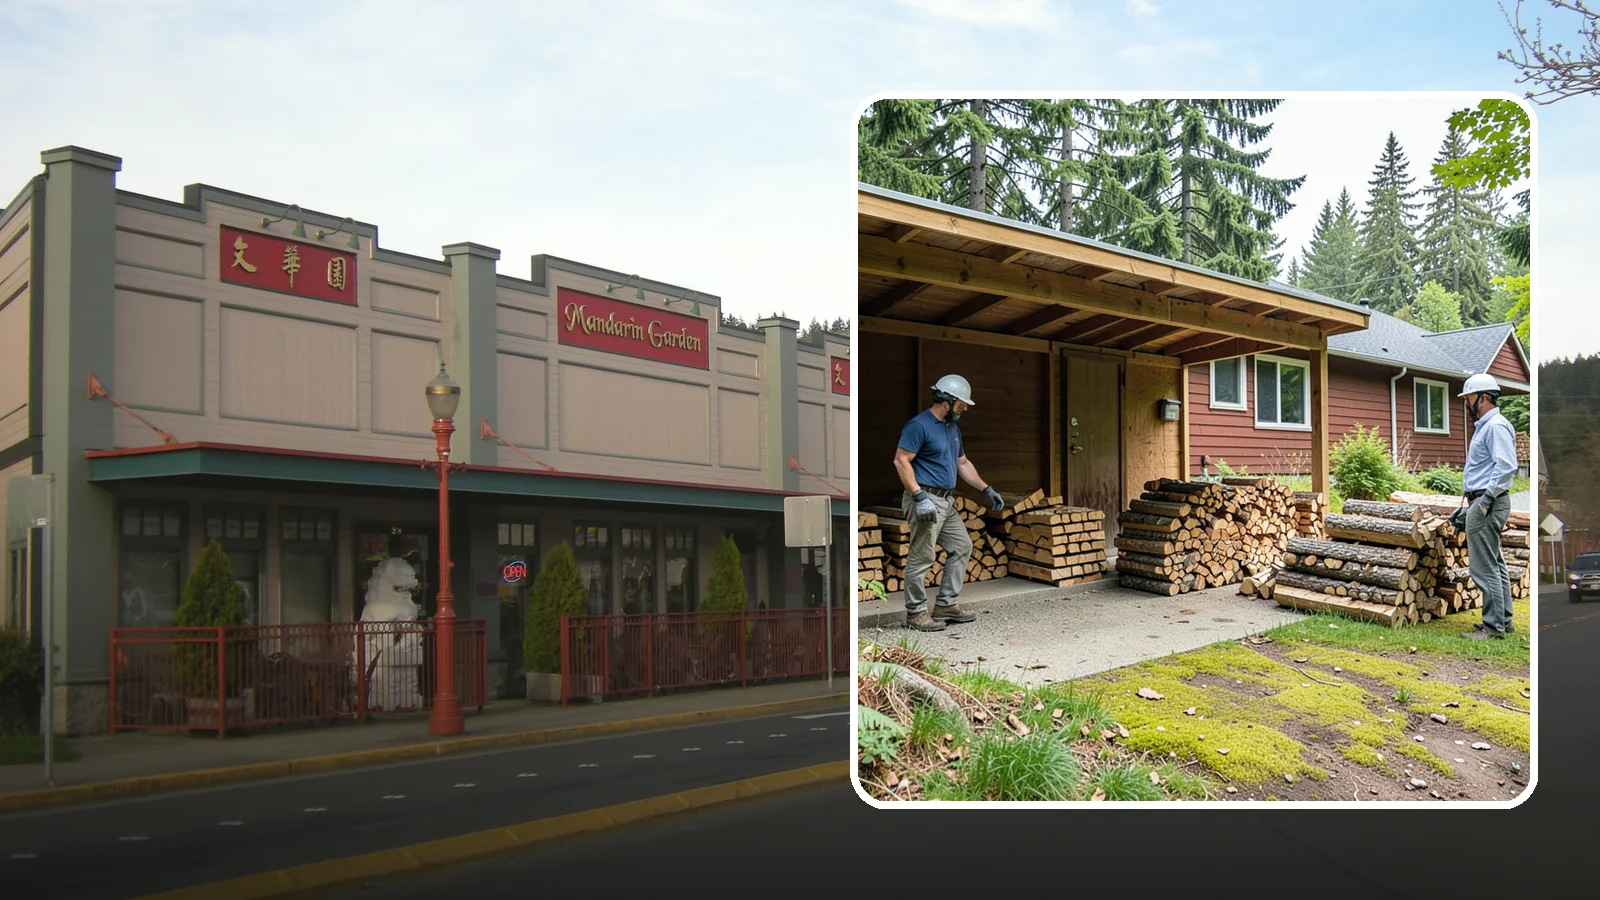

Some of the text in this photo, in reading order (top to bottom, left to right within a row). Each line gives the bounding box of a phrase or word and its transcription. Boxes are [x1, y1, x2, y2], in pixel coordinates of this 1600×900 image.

[230, 235, 346, 291] 文華園
[564, 302, 701, 352] Mandarin Garden
[503, 565, 527, 578] OPEN
